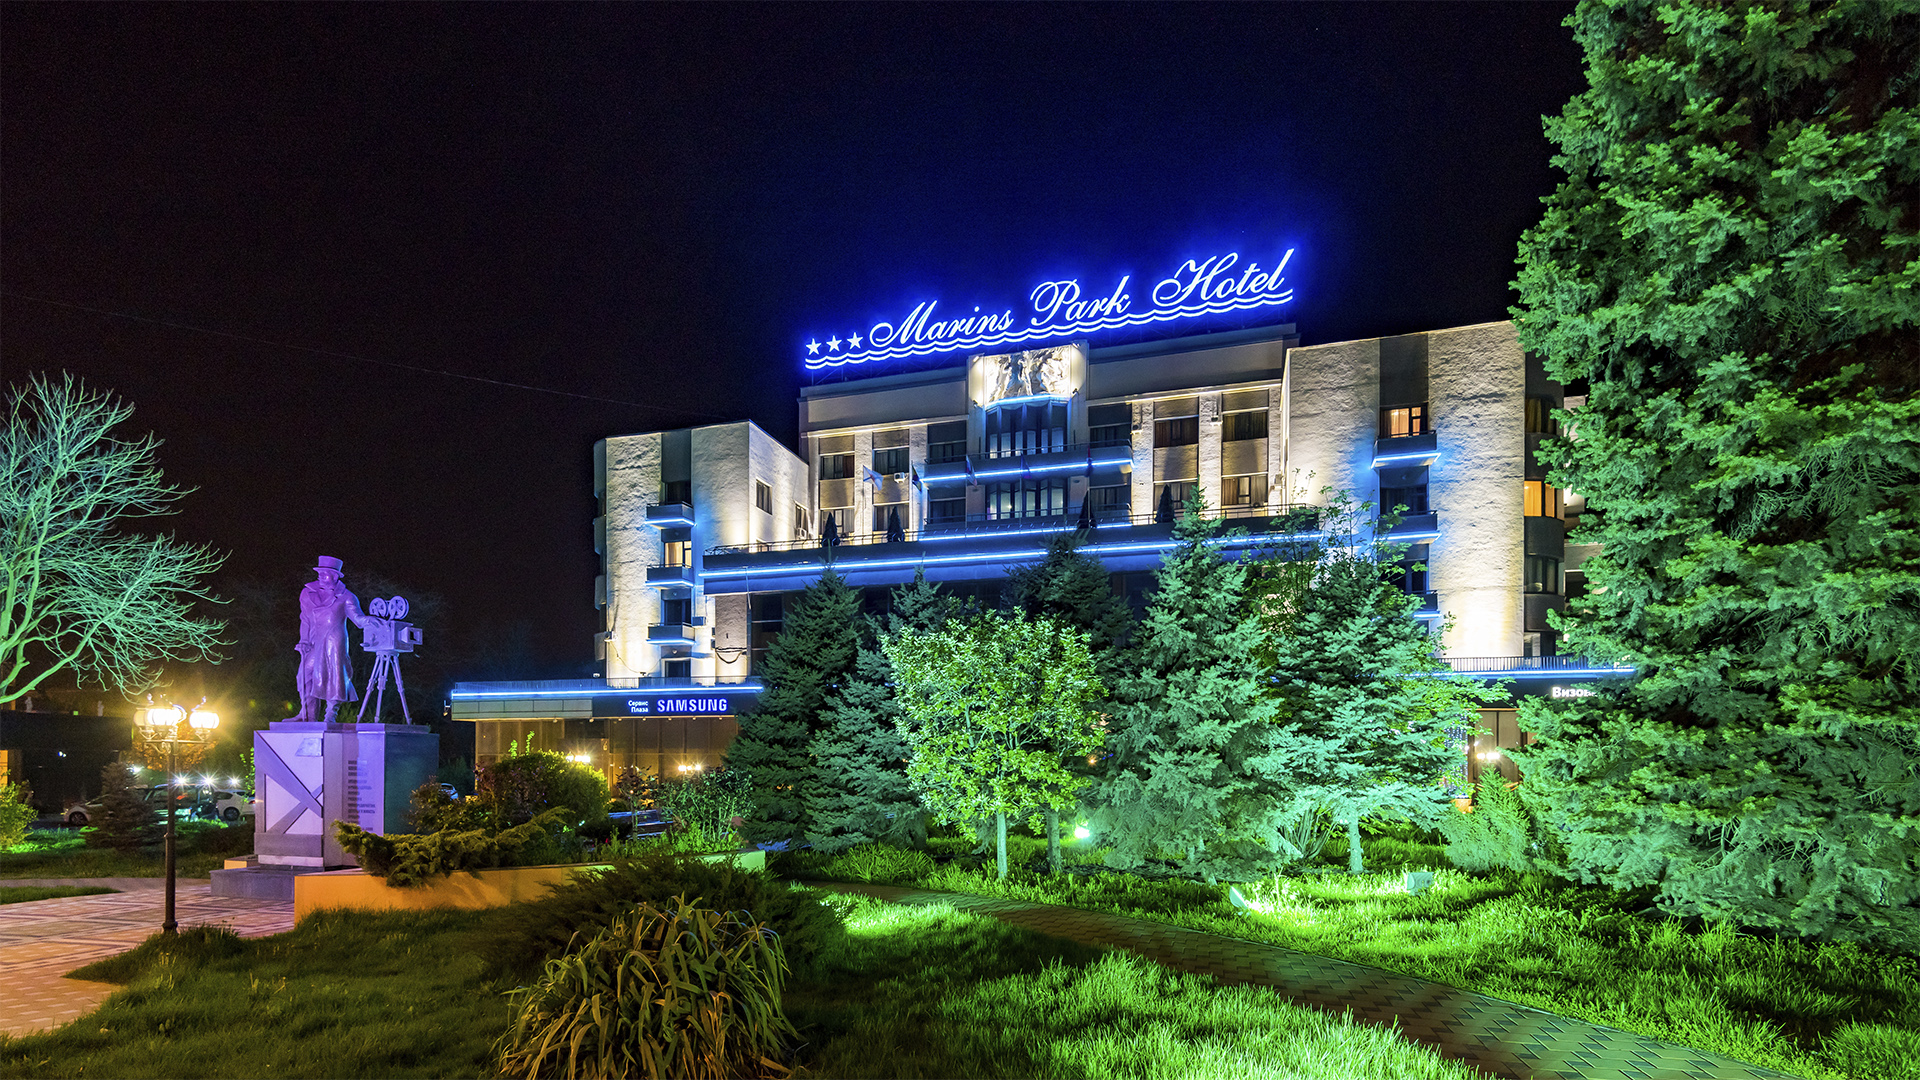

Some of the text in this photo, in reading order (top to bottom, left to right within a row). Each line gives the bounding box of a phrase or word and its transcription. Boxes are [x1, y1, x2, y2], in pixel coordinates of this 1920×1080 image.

[869, 248, 1294, 347] Marins Park Hotel
[657, 699, 728, 713] SAMSUNG
